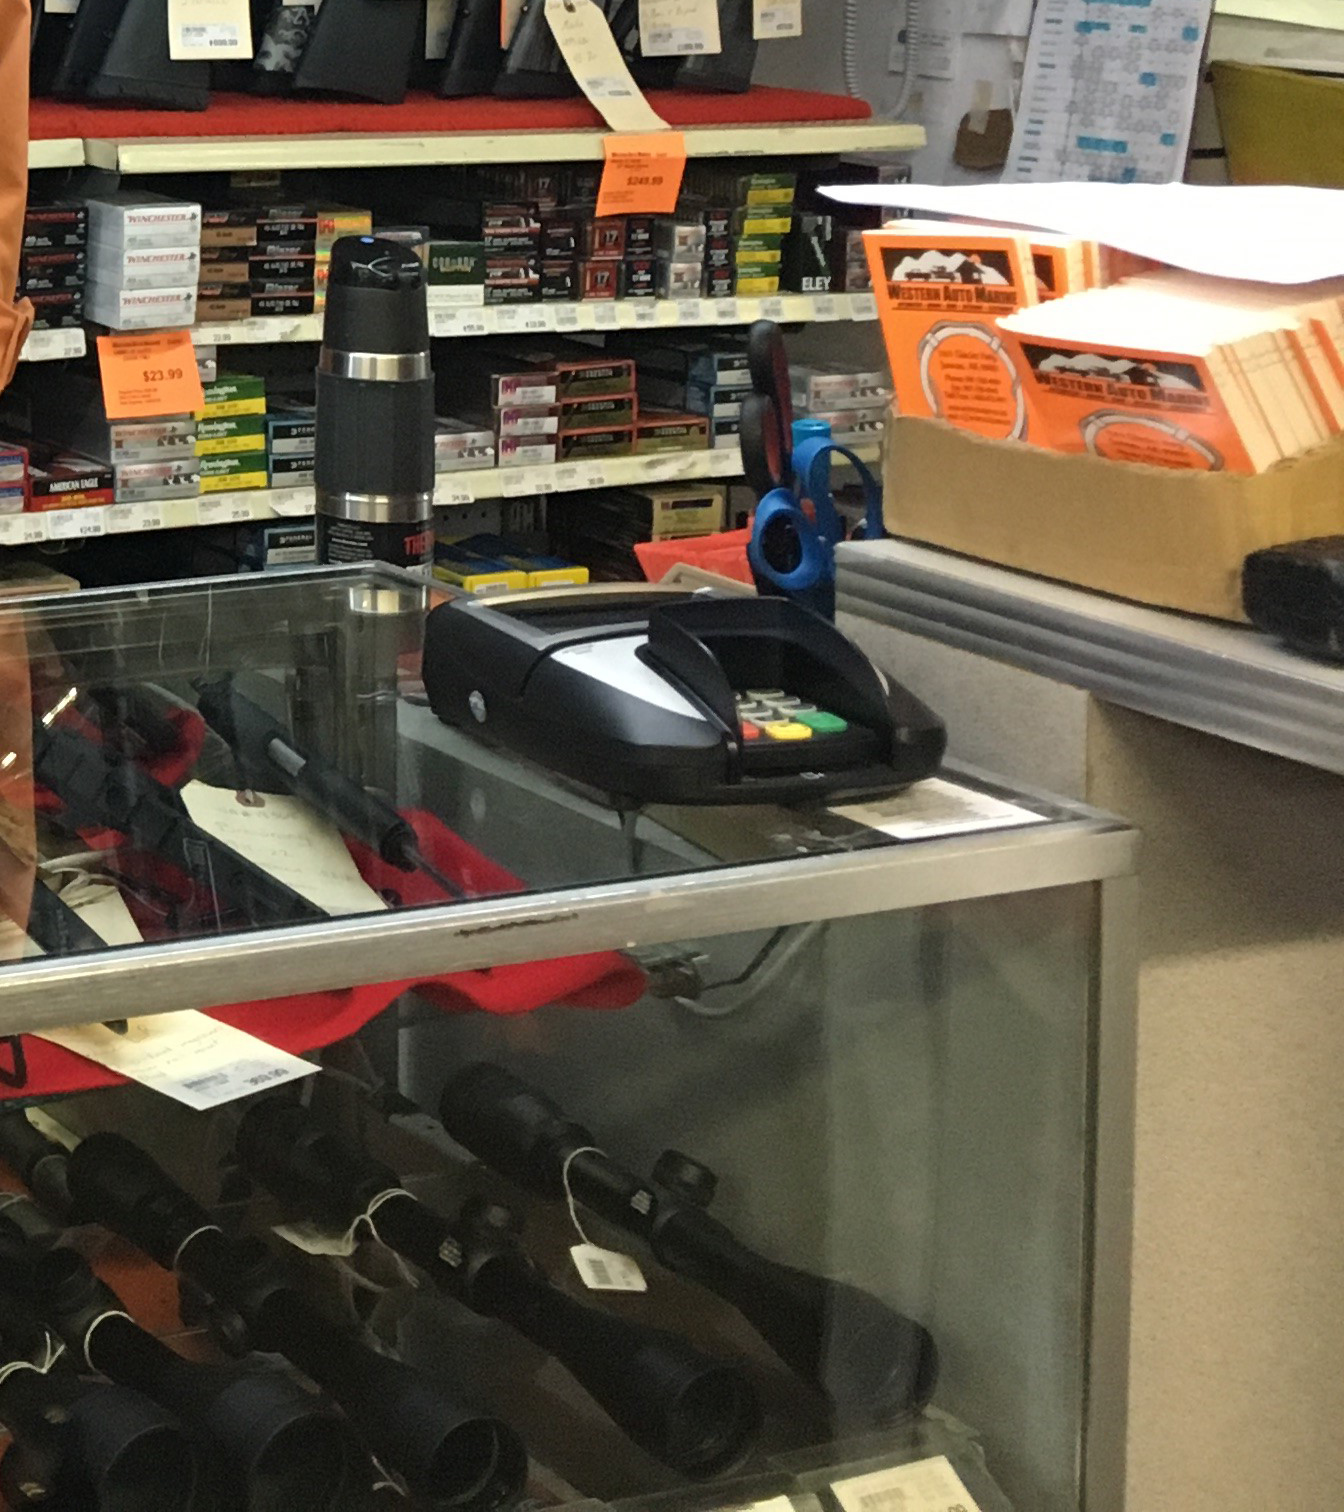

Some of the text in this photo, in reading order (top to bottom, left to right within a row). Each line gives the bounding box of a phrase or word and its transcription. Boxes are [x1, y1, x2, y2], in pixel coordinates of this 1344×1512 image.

[128, 213, 188, 225] WINCHESTER
[126, 253, 186, 265] WINCHESTER
[802, 275, 832, 291] ELEY
[889, 284, 941, 302] WESTERN
[944, 285, 973, 302] AUTO
[121, 295, 182, 307] WINCHESTER
[142, 367, 183, 384] $23.99
